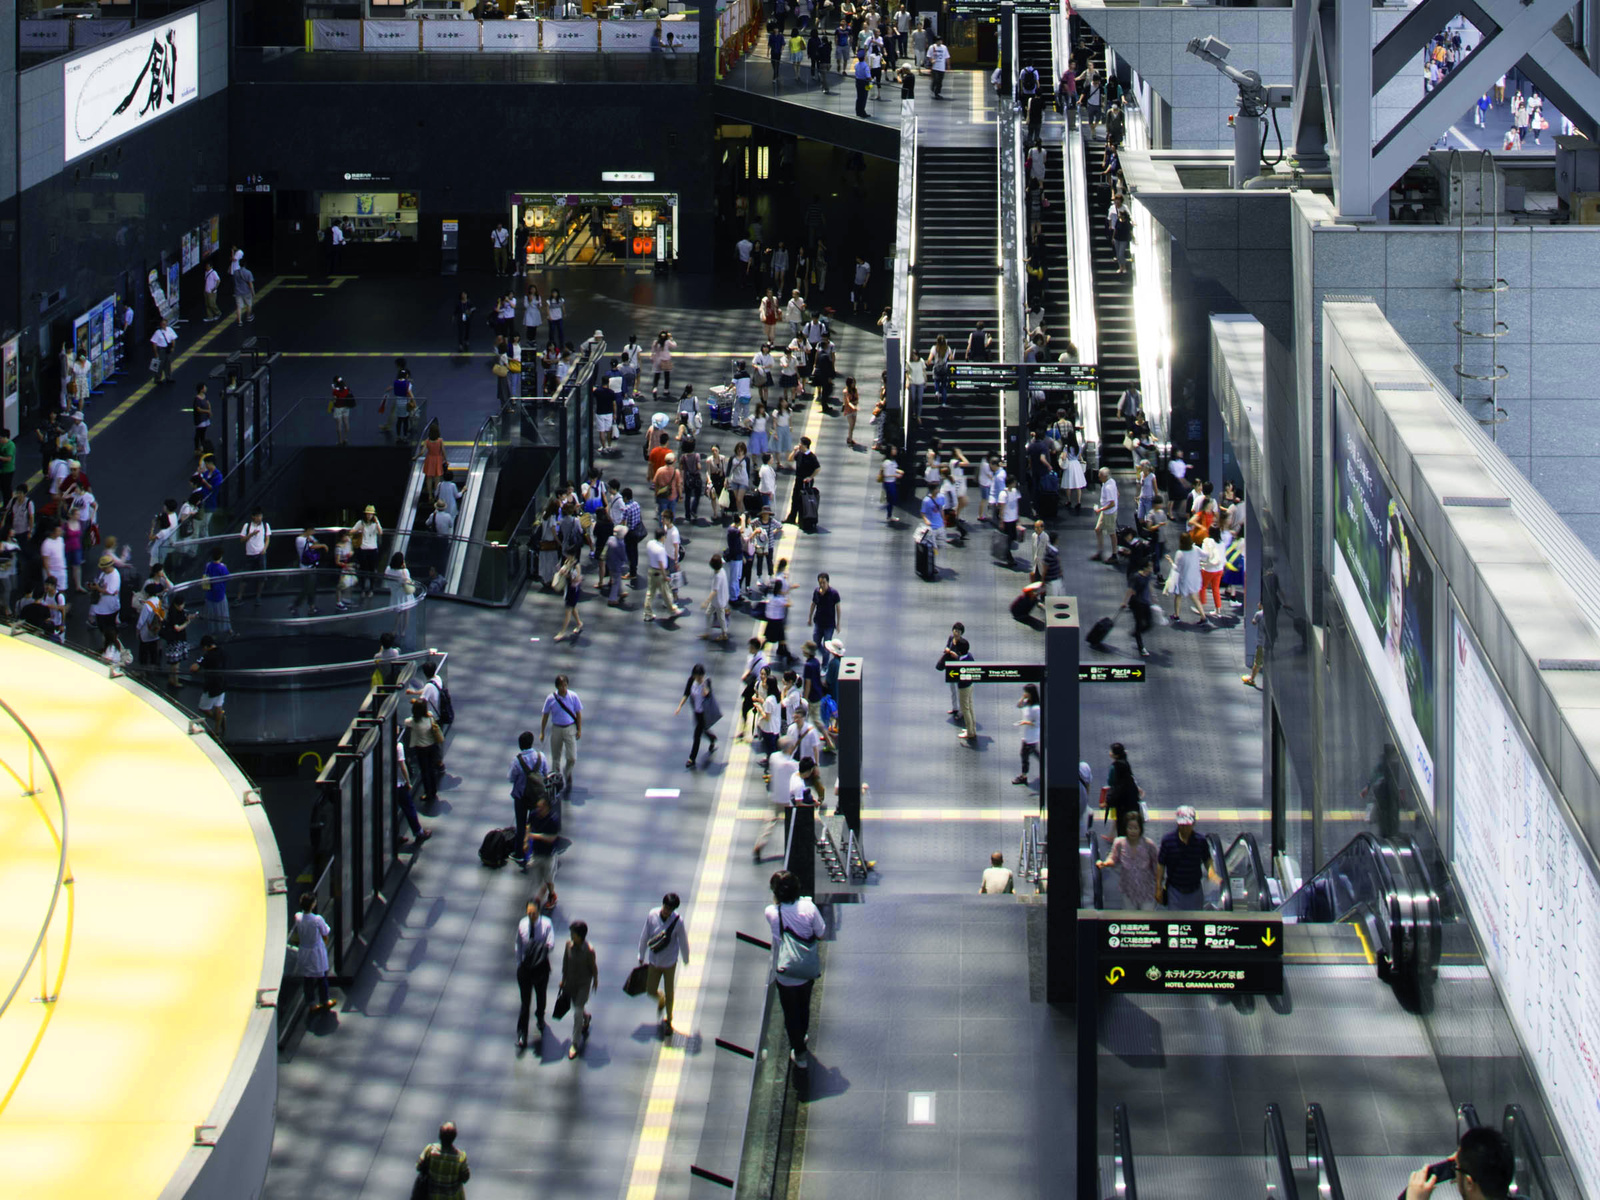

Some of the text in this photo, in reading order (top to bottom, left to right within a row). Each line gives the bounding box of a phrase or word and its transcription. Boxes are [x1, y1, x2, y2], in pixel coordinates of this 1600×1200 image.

[1205, 938, 1236, 946] Porta
[1165, 970, 1245, 979] ホテルグランヴィア京都
